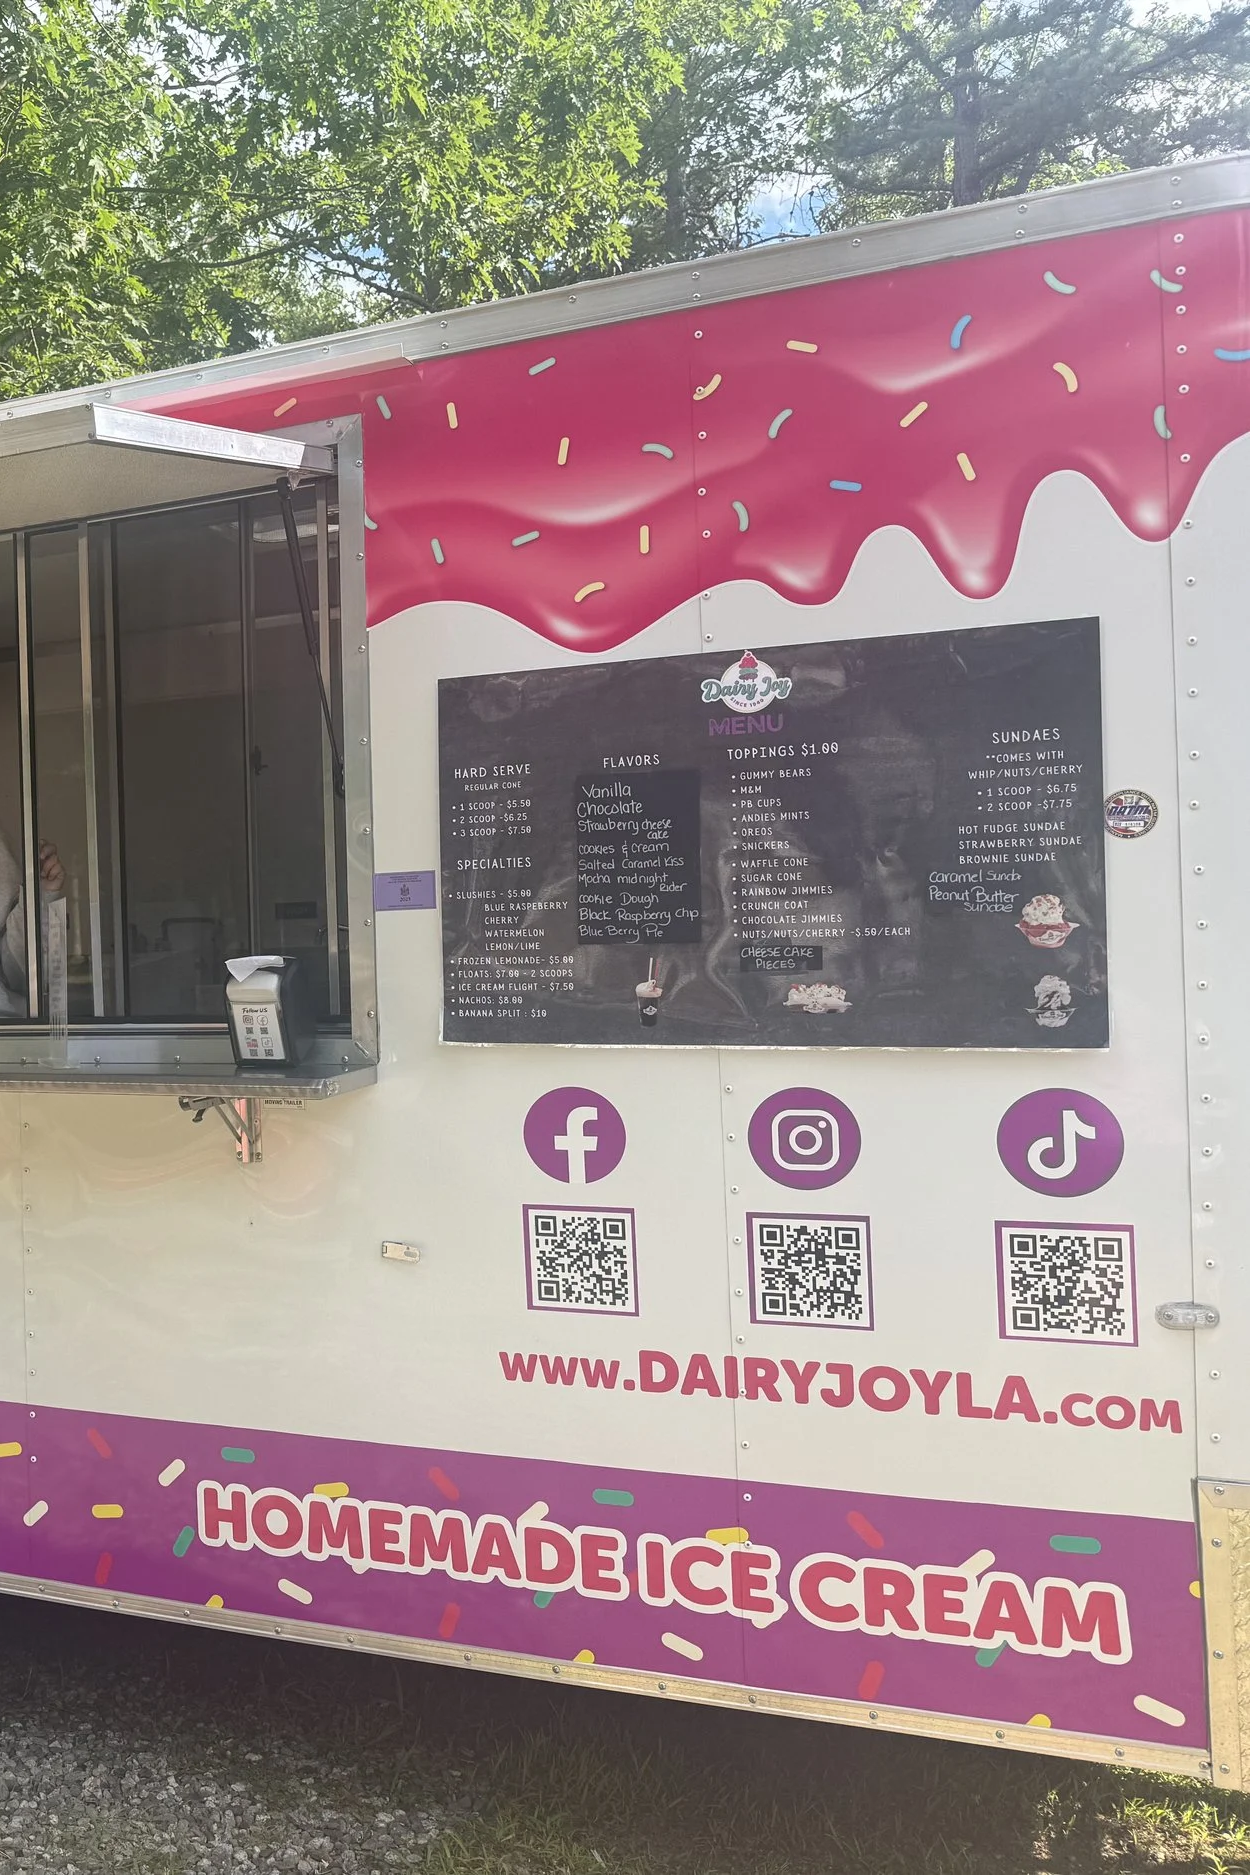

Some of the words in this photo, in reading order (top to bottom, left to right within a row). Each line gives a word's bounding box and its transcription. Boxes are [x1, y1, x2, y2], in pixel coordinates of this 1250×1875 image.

[702, 680, 759, 701] Dairy
[759, 676, 791, 697] Joy
[708, 713, 785, 736] MENU
[992, 728, 1061, 744] SUNDAES
[727, 745, 795, 760] TOPPINGS
[801, 742, 839, 757] $1.00
[1036, 751, 1064, 761] WITH
[603, 754, 660, 768] FLAVORS
[454, 767, 487, 779] HARD
[493, 763, 531, 776] SERVE
[740, 770, 775, 780] GUMMY
[779, 768, 812, 778] BEARS
[968, 764, 1083, 780] WHIP/NUTS/CHERRY
[464, 782, 499, 791] REGULAR
[502, 780, 522, 789] CONE
[582, 782, 631, 798] Vanilla
[740, 786, 762, 794] M&M
[987, 788, 992, 797] 1
[998, 786, 1032, 796] SCOOP
[1046, 783, 1077, 795] $6.75
[459, 803, 465, 811] 1
[468, 801, 496, 811] SCOOP
[506, 799, 531, 810] $5.50
[577, 800, 643, 818] Chocolate
[741, 800, 753, 808] PB
[757, 799, 782, 807] CUPS
[987, 803, 993, 812] 2
[998, 801, 1032, 811] SCOOP
[459, 816, 465, 824] 2
[468, 814, 496, 824] SCOOP
[741, 813, 776, 822] ANDIES
[780, 811, 810, 821] MINTS
[460, 829, 466, 837] 3
[469, 827, 497, 837] SCOOP
[507, 825, 532, 836] $7.50
[578, 818, 639, 836] Strawberry
[642, 818, 673, 830] cheese
[741, 827, 773, 837] OREOS
[958, 825, 978, 835] HOT
[983, 823, 1019, 833] FUDGE
[1024, 822, 1066, 831] SUNDAE
[647, 830, 669, 840] cake
[742, 841, 790, 851] SNICKERS
[959, 838, 1034, 850] STRAWBERRY
[1039, 836, 1082, 846] SUNDAE
[457, 856, 532, 871] SPECIALTIES
[578, 859, 615, 871] Salted
[622, 857, 661, 869] Caramel
[740, 859, 779, 868] WAFFLE
[783, 858, 809, 867] CONE
[959, 854, 1009, 865] BROWNIE
[1014, 853, 1057, 863] SUNDAE
[578, 874, 611, 888] Mocha
[617, 872, 669, 888] midnight
[741, 873, 773, 883] SUGAR
[777, 872, 802, 881] CONE
[456, 890, 496, 900] SLUSHIES
[507, 889, 532, 898] $5.00
[741, 887, 787, 897] RAINBOW
[791, 885, 833, 895] JIMMIES
[929, 886, 970, 901] Peanut
[971, 886, 1020, 903] Butter
[620, 892, 659, 909] Dough
[741, 901, 780, 911] CRUNCH
[784, 900, 809, 909] COAT
[484, 903, 506, 912] BLUE
[509, 901, 568, 911] RASPEBERRY
[578, 907, 612, 921] Black
[742, 915, 797, 925] CHOCOLATE
[801, 914, 843, 923] JIMMIES
[484, 916, 519, 925] CHERRY
[485, 929, 545, 938] WATERMELON
[641, 922, 664, 937] Pie
[742, 928, 846, 939] NUTS/NUTS/CHERRY
[485, 942, 541, 951] LEMON/LIME
[741, 947, 781, 958] CHEESE
[784, 947, 815, 958] CAKE
[458, 957, 491, 965] FROZEN
[549, 955, 574, 965] $5.00
[756, 959, 796, 970] PIECES
[458, 970, 492, 978] FLOATS:
[495, 969, 520, 979] $7.00
[531, 970, 536, 978] 2
[539, 969, 573, 978] SCOOPS
[458, 983, 472, 991] ICE
[475, 983, 505, 991] CREAM
[508, 983, 538, 991] FLIGHT
[550, 982, 574, 992] $7.50
[459, 996, 495, 1004] NACHOS:
[499, 996, 523, 1005] $8.00
[459, 1009, 494, 1018] BANANA
[497, 1009, 521, 1018] SPLIT
[531, 1009, 547, 1018] $10
[203, 1487, 630, 1593] HOMEMADE
[646, 1541, 779, 1615] ICE
[796, 1560, 1123, 1657] CREAM
